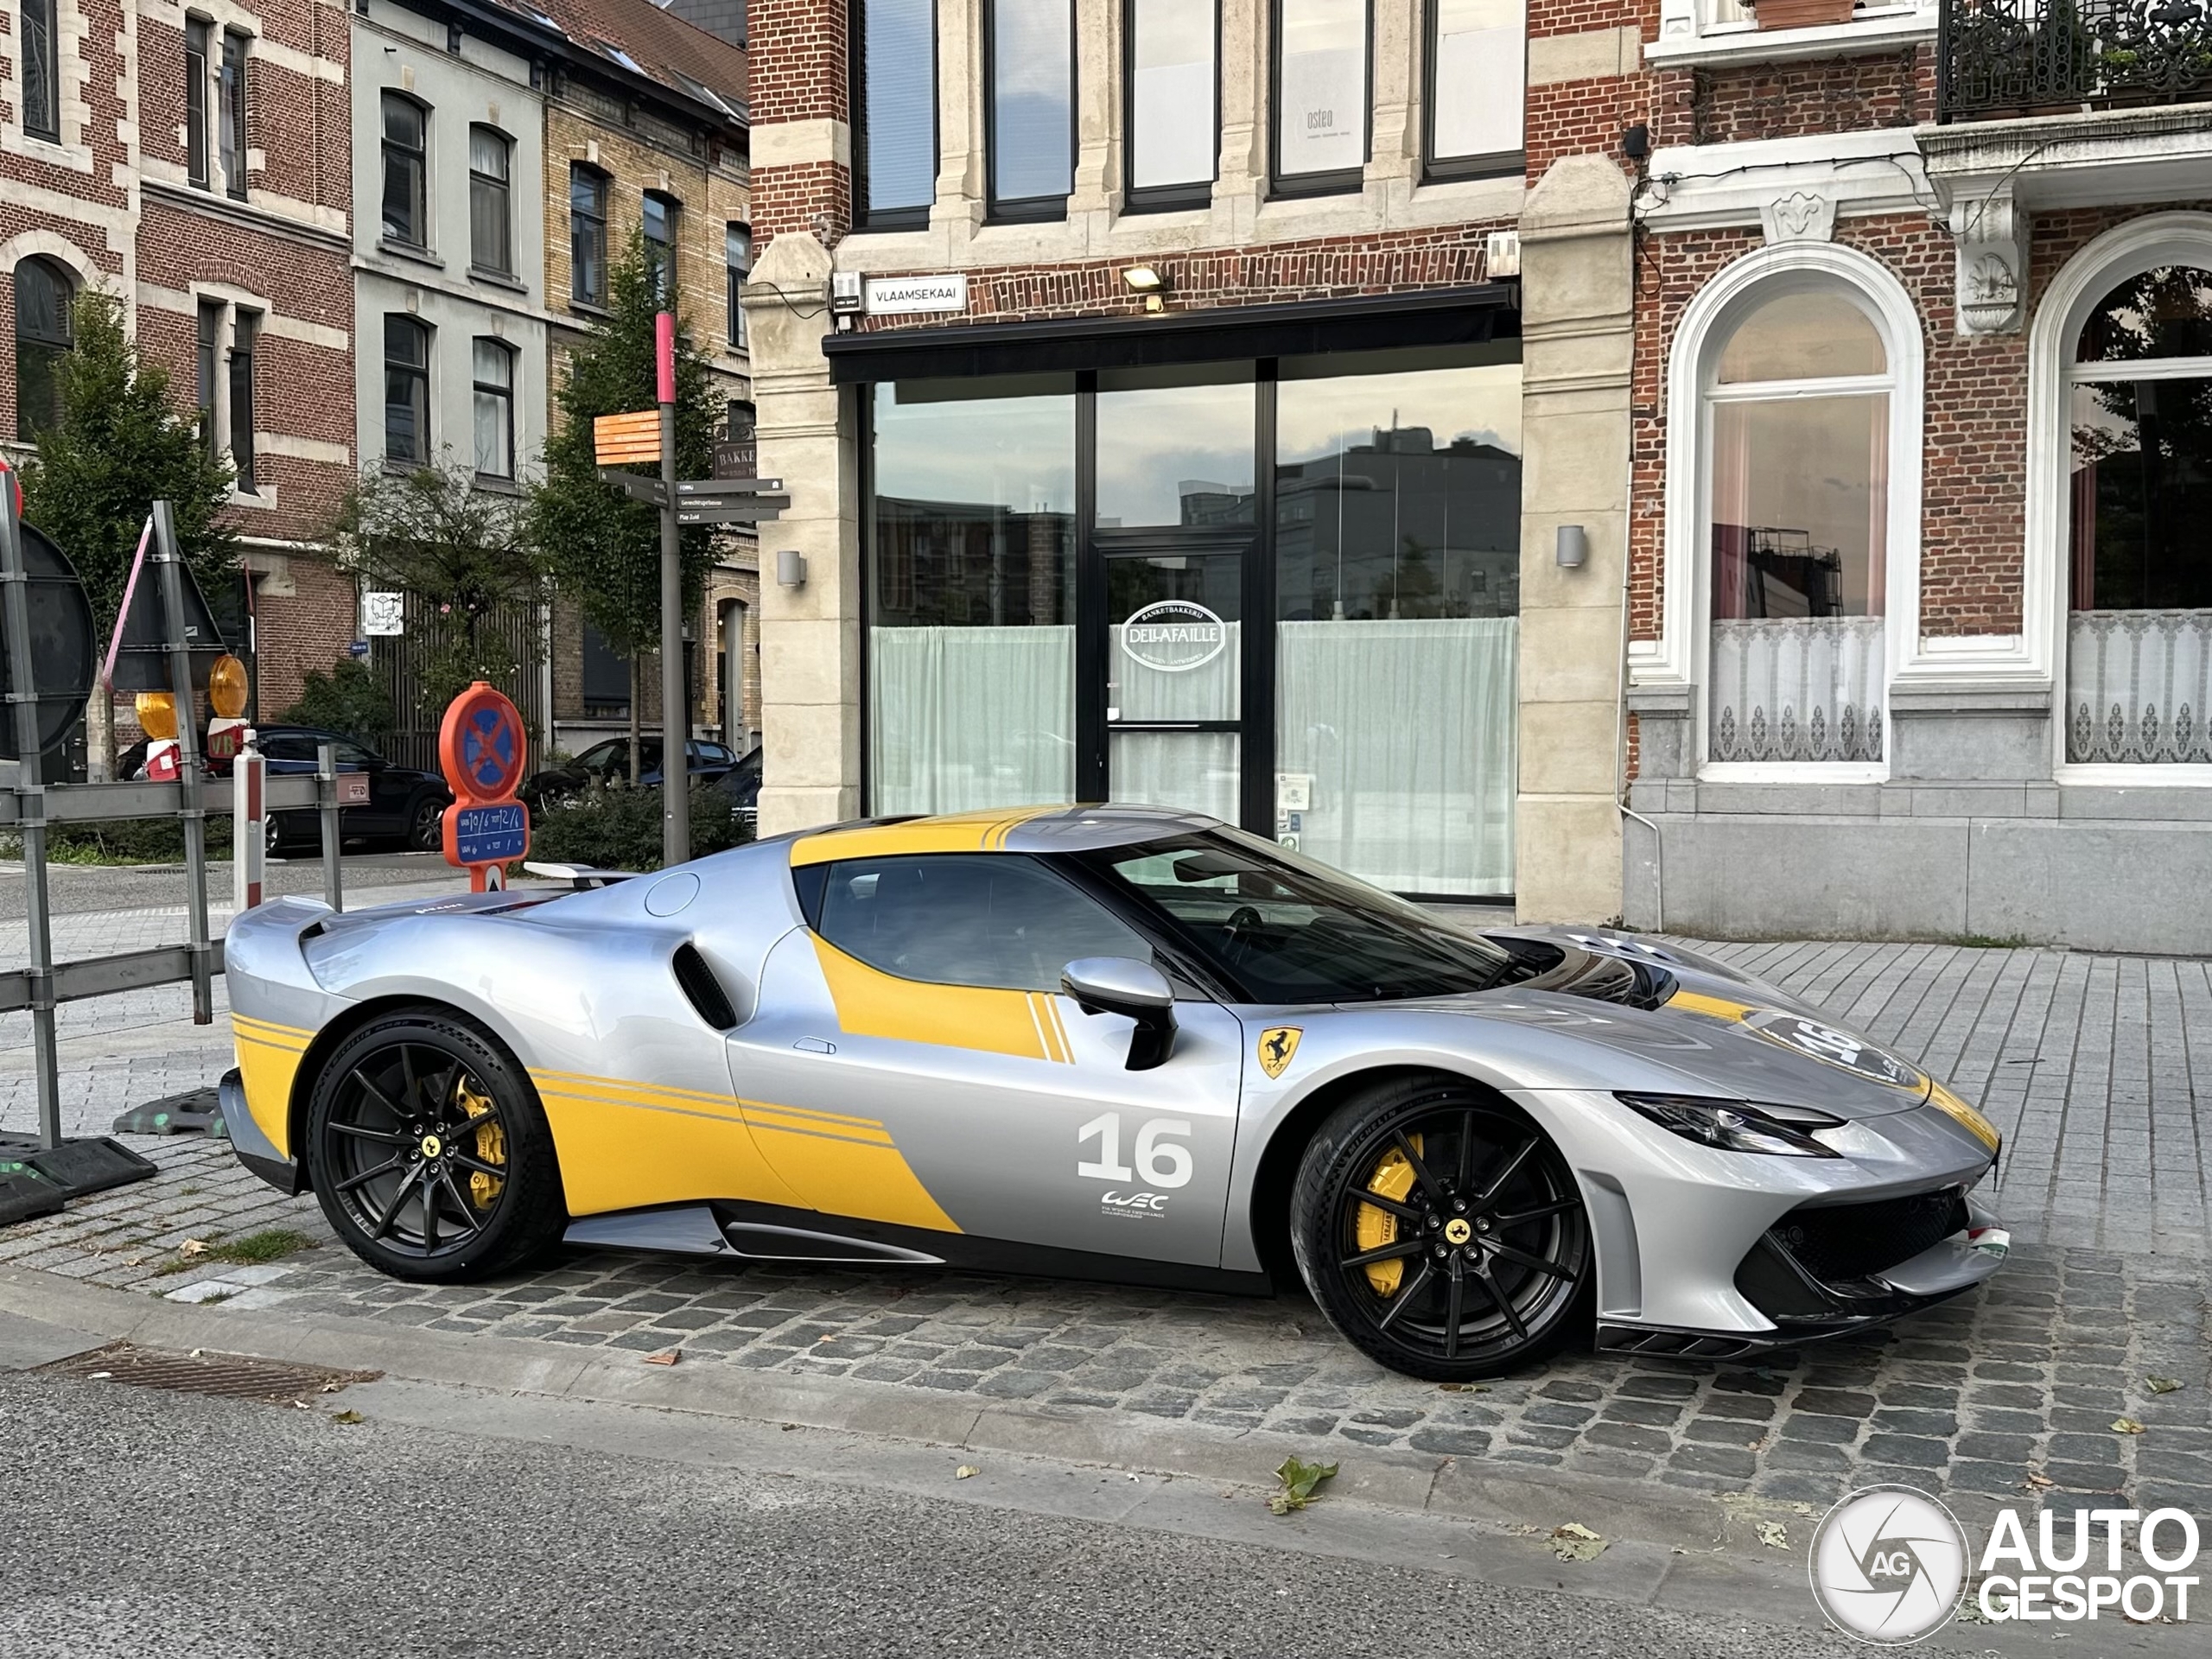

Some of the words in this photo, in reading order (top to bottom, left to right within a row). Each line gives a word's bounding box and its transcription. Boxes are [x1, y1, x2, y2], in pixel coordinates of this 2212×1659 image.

[1307, 109, 1332, 129] osteo
[876, 288, 956, 302] VLAAMSEKAAI
[1141, 607, 1204, 621] BANKETBAKKERIJ
[1129, 627, 1217, 643] DELLAFAILLE
[1348, 1109, 1396, 1154] MICHELIN
[1078, 1112, 1192, 1188] 16
[1102, 1191, 1169, 1210] WEC
